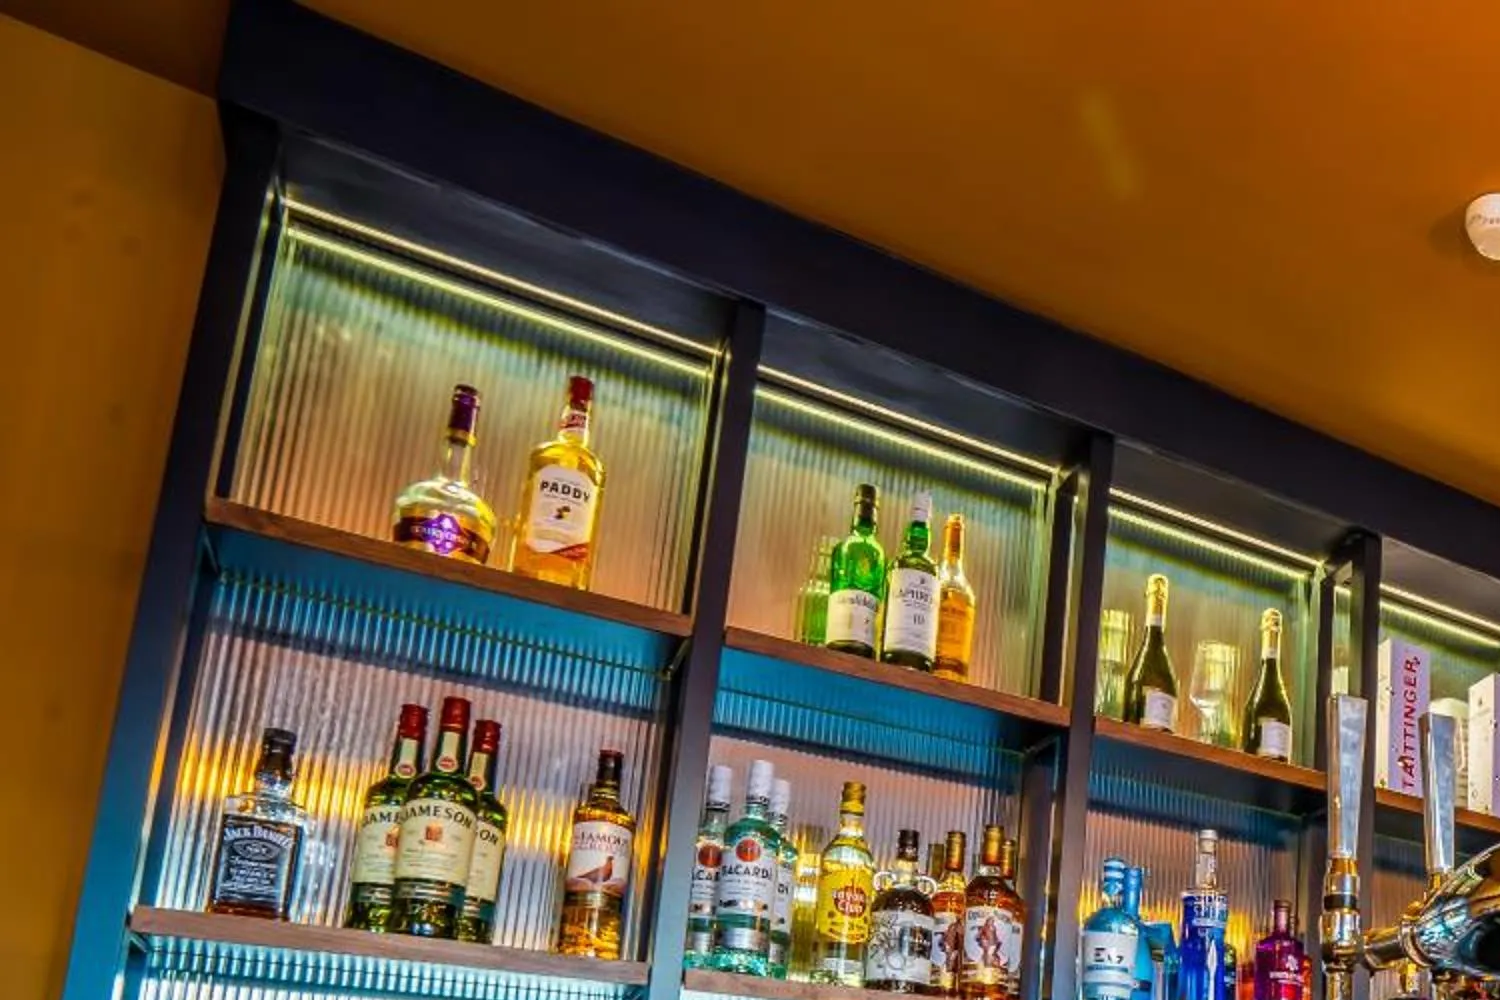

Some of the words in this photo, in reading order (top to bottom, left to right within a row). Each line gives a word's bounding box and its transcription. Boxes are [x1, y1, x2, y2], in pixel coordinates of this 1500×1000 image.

[540, 480, 590, 502] PADDY
[1398, 656, 1421, 788] TAITTINGER
[404, 804, 473, 829] JAMESON
[475, 828, 499, 846] ON
